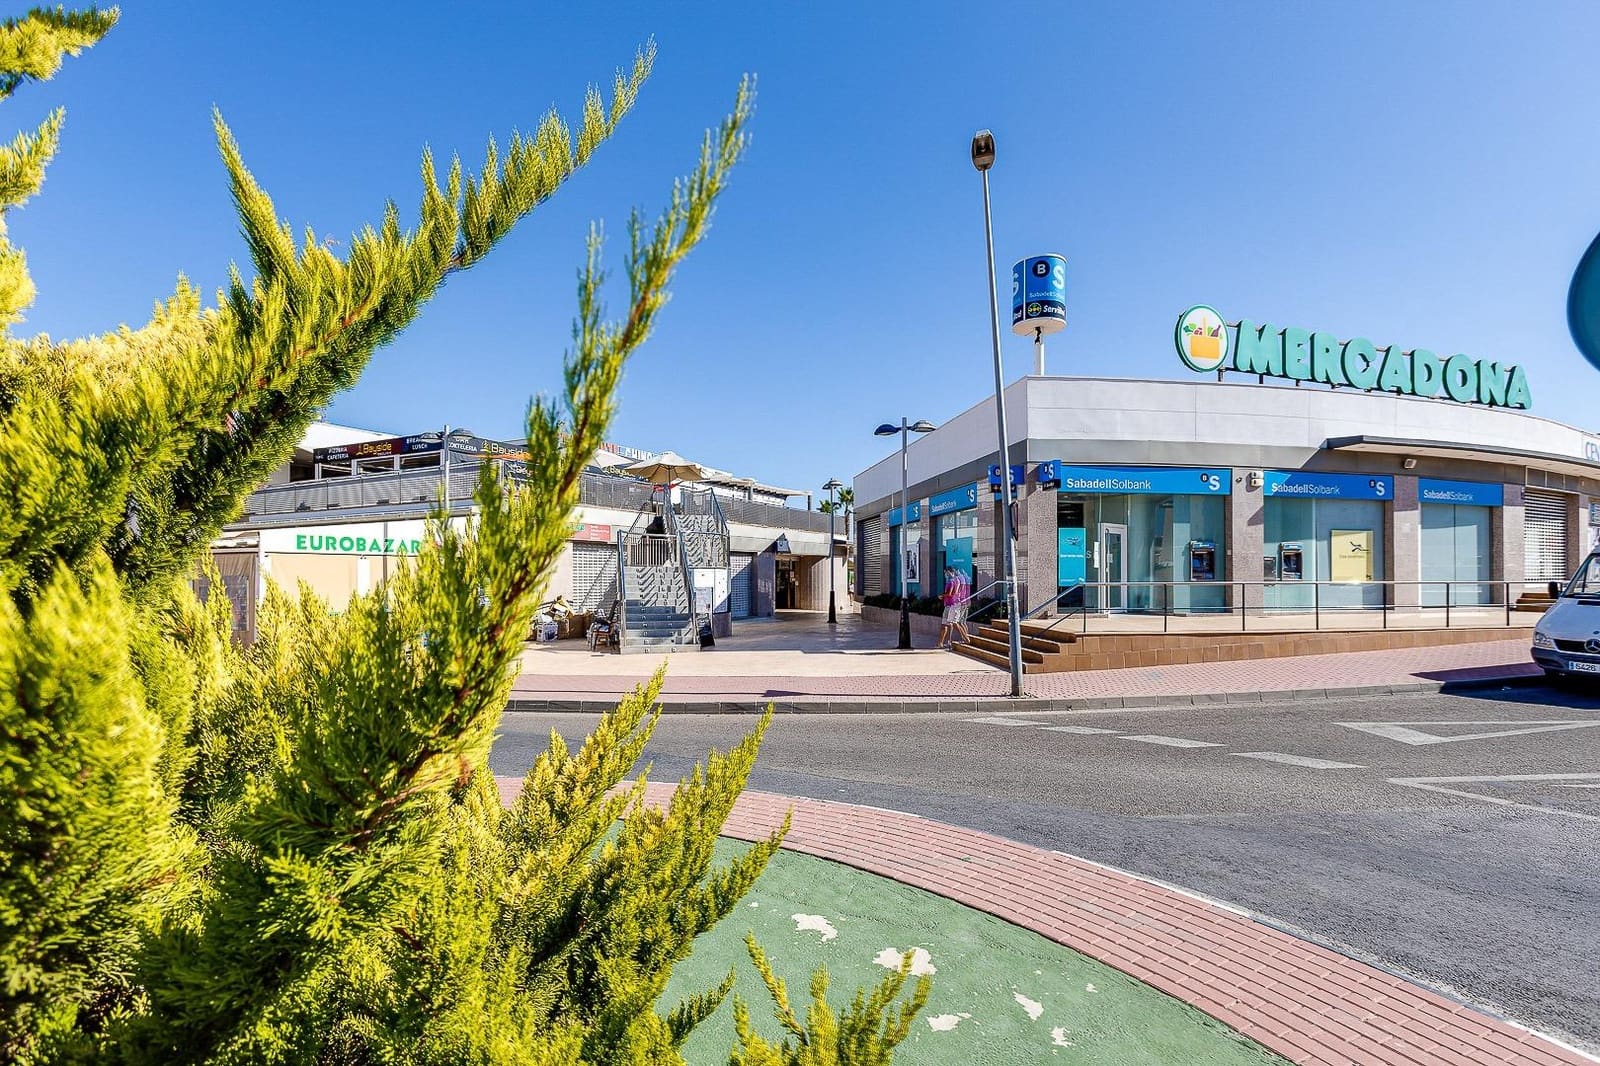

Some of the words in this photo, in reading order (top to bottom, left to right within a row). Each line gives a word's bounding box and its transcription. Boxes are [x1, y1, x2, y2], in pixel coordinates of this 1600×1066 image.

[1037, 263, 1046, 275] B
[1053, 265, 1065, 290] S
[1233, 319, 1533, 410] MERCADONA
[362, 442, 392, 455] Bayside
[491, 442, 531, 458] Bayside
[1066, 477, 1151, 491] SabadellSolbank
[1208, 475, 1221, 491] S
[1271, 482, 1340, 495] SabadellSolbank
[1376, 481, 1386, 496] S
[1423, 489, 1474, 501] SabadellSolbank
[296, 534, 421, 553] EUROBAZAR
